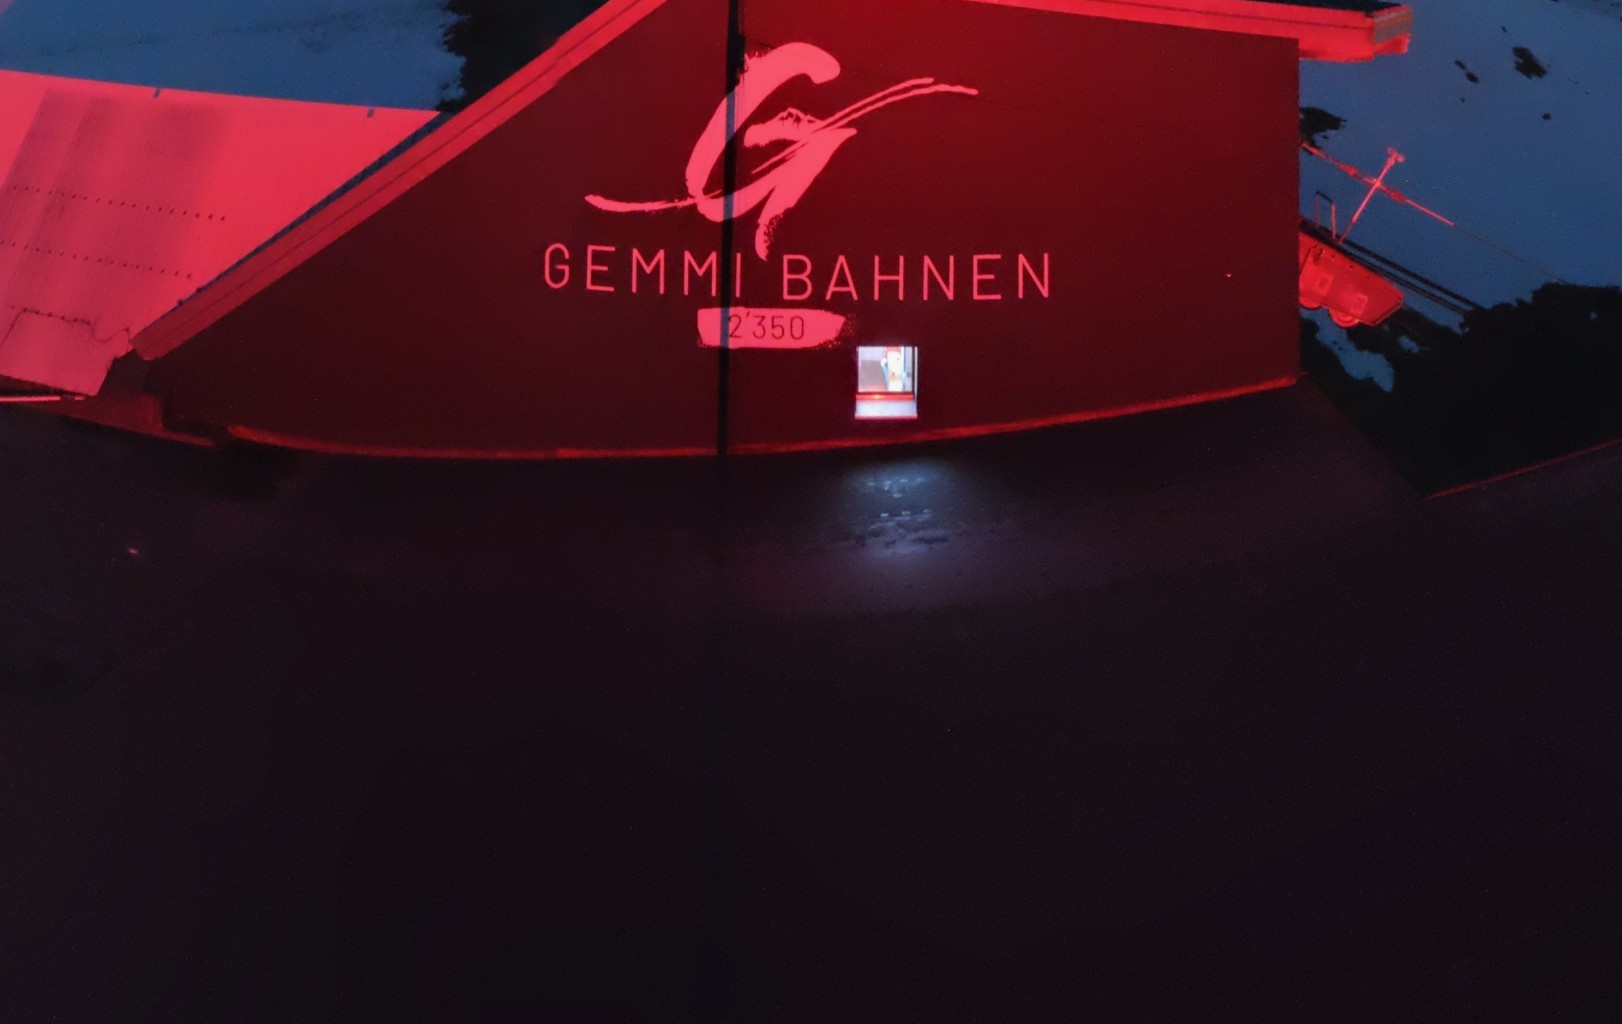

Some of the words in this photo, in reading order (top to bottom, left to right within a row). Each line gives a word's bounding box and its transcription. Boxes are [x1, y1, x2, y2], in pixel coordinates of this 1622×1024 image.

[544, 242, 742, 298] GEMMI
[781, 253, 1050, 301] BAHNEN
[727, 310, 805, 341] 2'350
